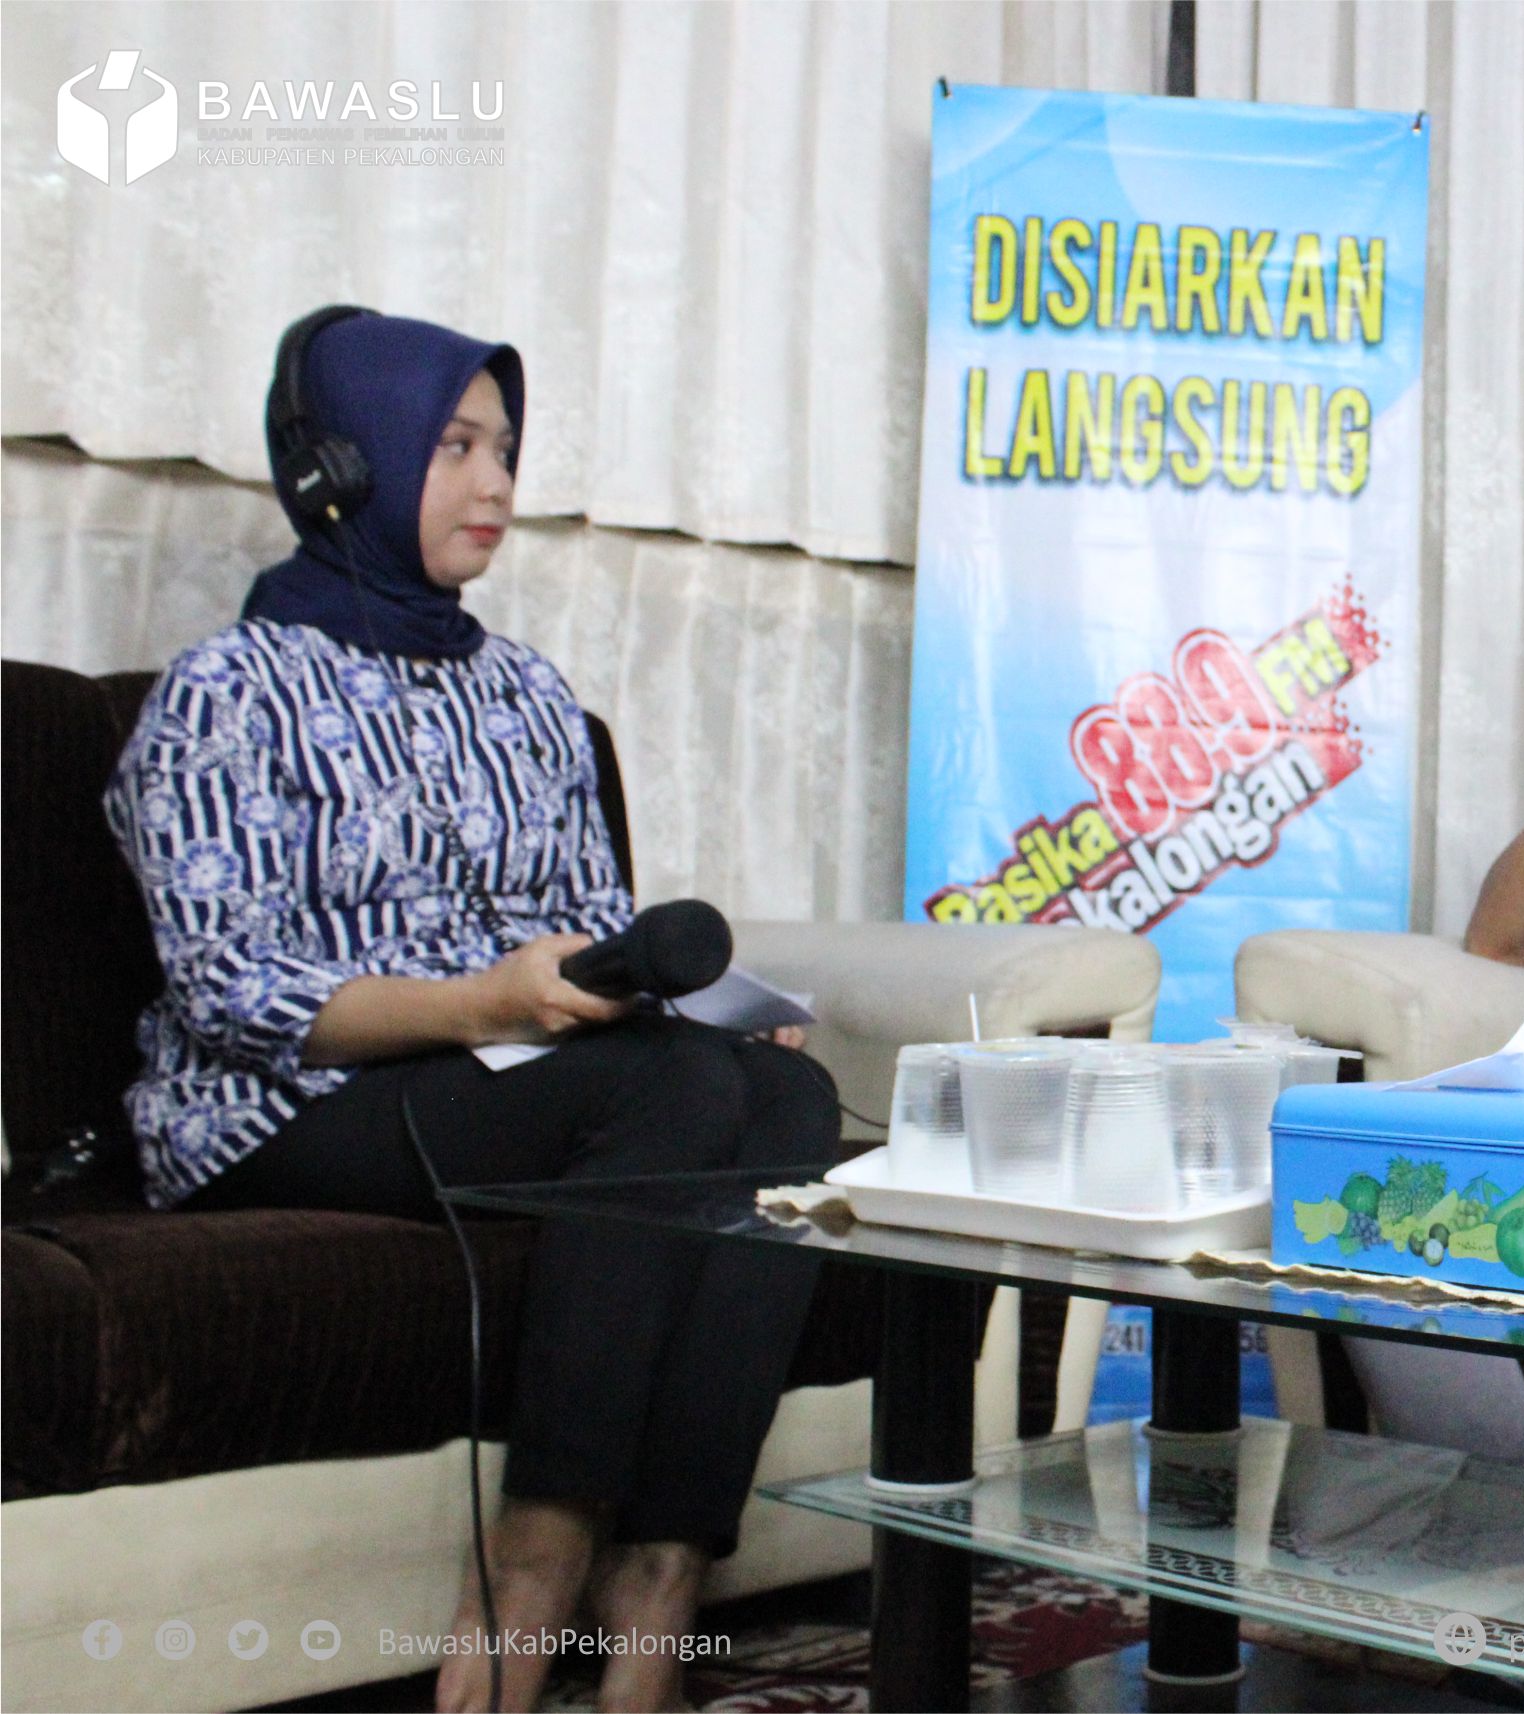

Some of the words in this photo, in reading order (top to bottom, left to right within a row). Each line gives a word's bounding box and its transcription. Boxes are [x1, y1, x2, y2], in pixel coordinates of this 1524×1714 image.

[970, 213, 1388, 346] DISIARKAN
[963, 366, 1373, 498] LANGSUNG
[1254, 616, 1352, 717] FM
